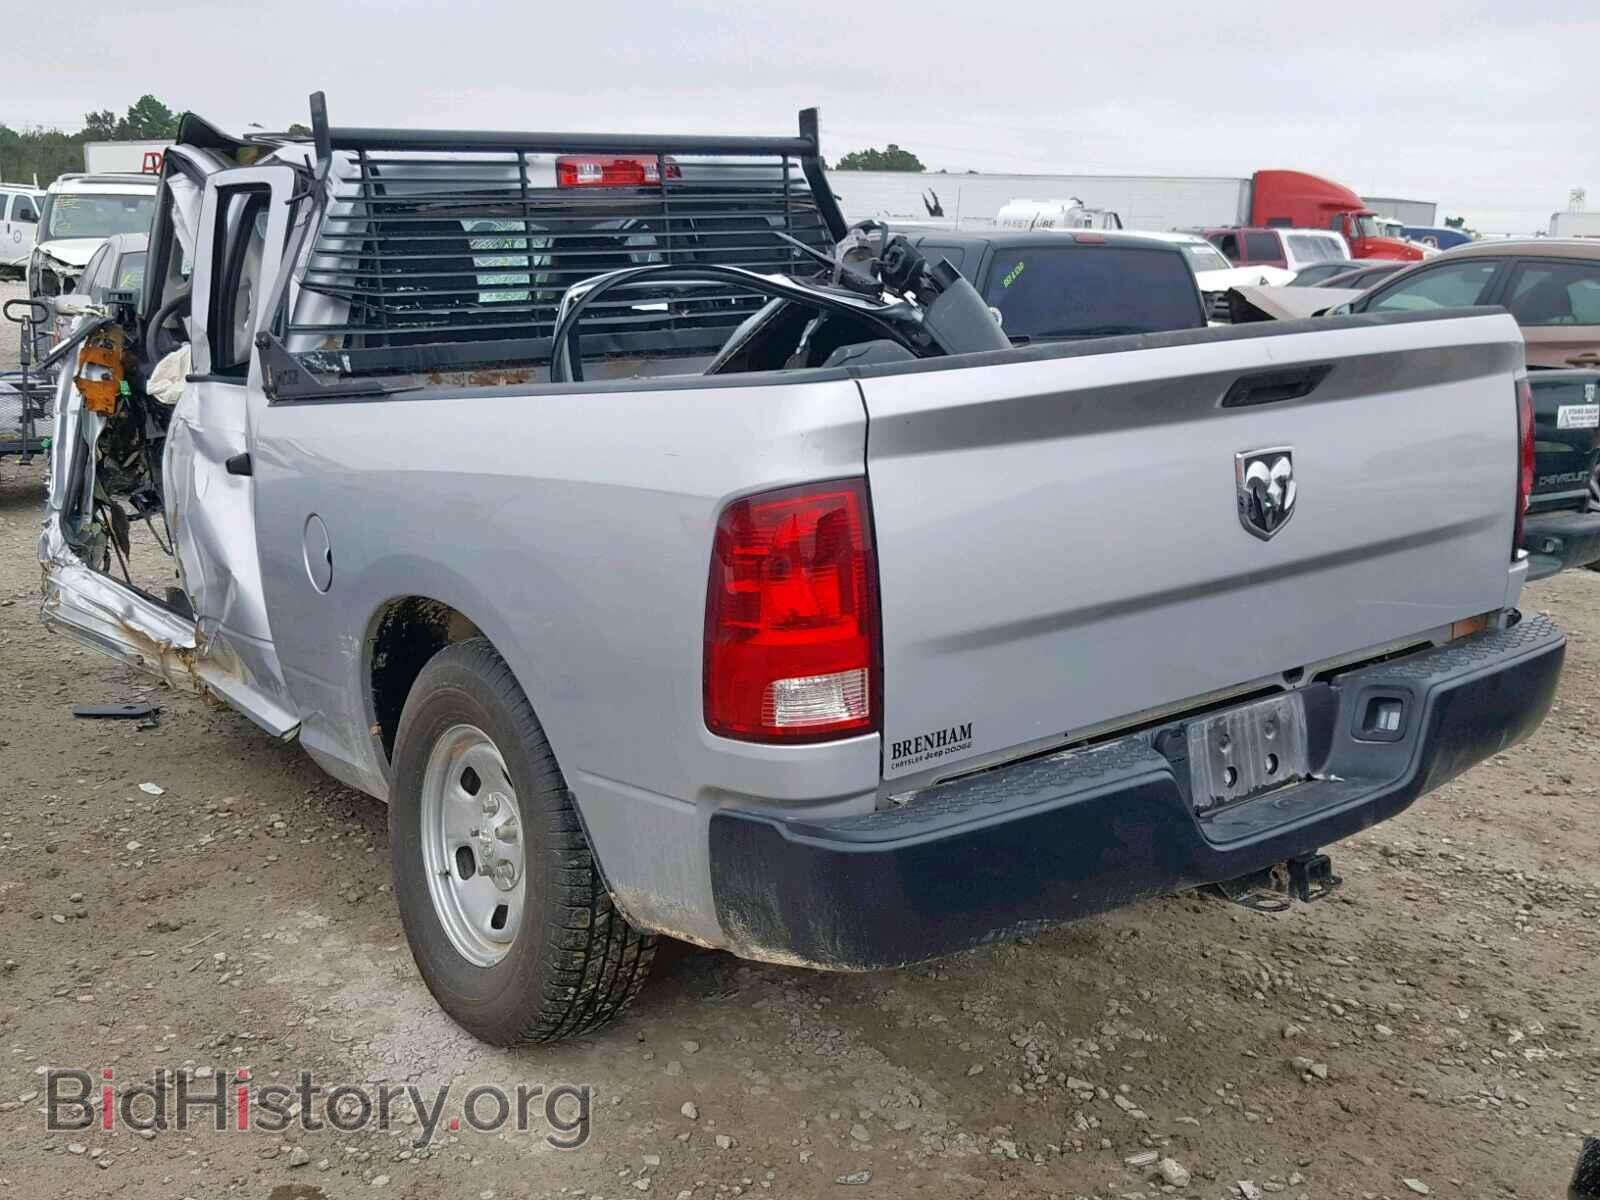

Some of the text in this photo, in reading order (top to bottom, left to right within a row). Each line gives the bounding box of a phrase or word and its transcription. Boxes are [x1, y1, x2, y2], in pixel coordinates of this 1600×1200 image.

[1538, 471, 1589, 486] CHEVROLET
[891, 722, 972, 760] BRENHAM
[891, 755, 922, 770] CHRYSLER
[944, 742, 972, 755] DODGE
